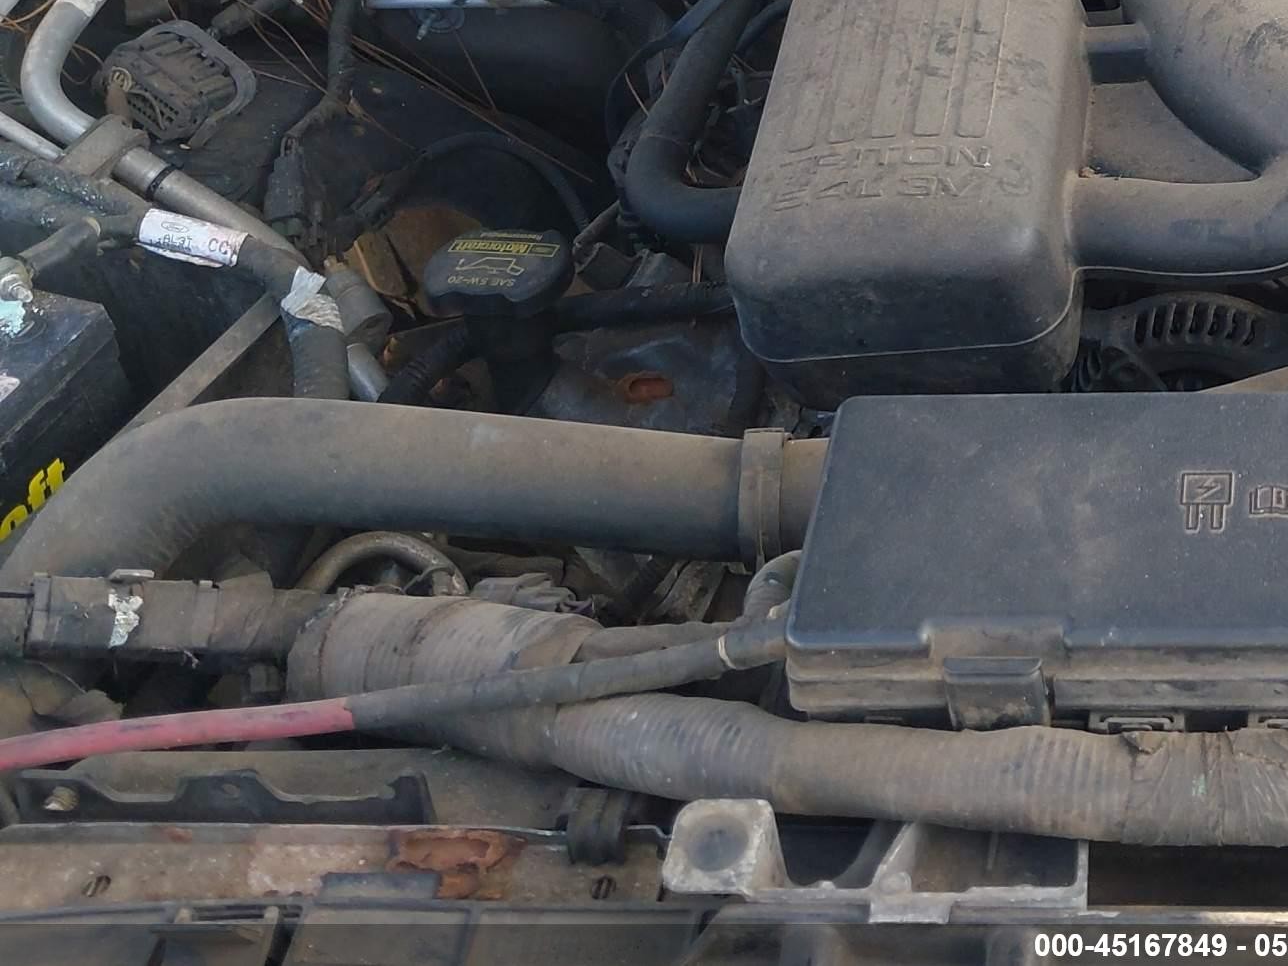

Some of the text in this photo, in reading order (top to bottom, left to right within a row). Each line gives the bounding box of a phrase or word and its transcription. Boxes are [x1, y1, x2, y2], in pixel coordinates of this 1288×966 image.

[455, 241, 529, 254] Motorcraft
[447, 274, 517, 288] SAE 5W-20
